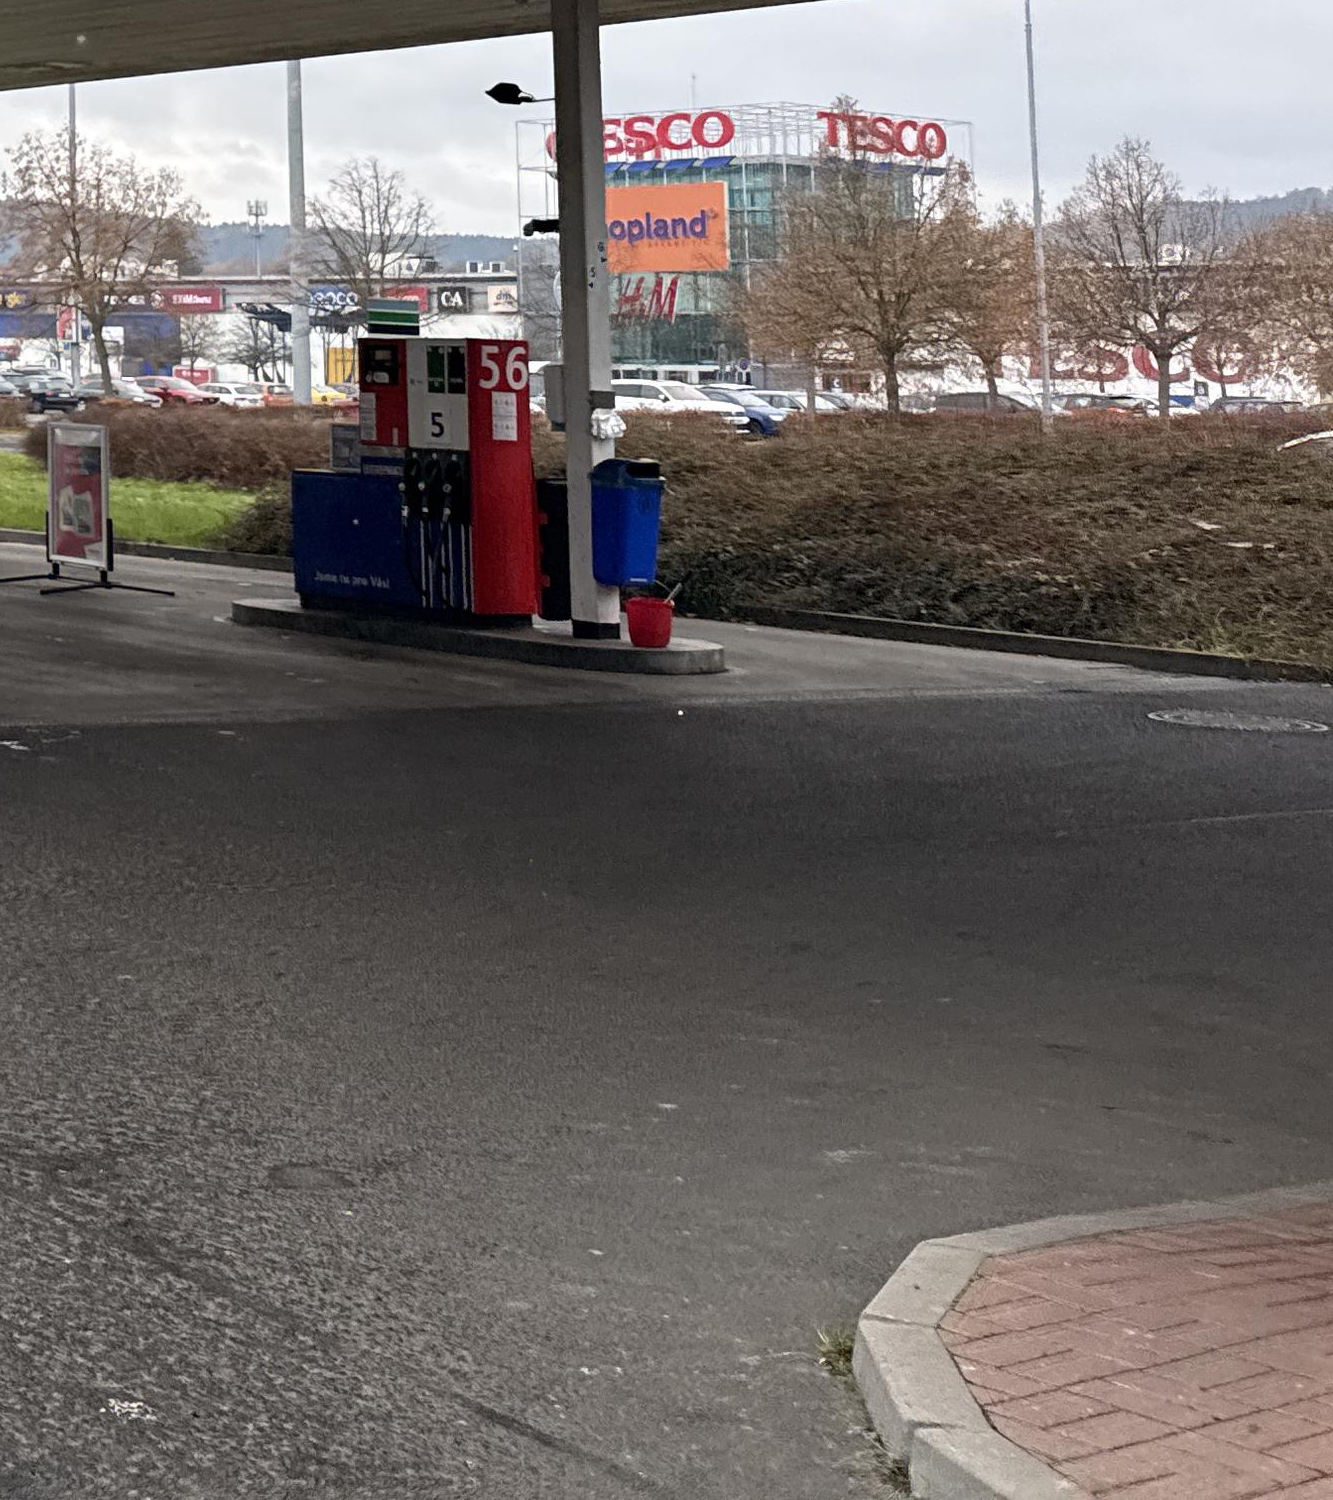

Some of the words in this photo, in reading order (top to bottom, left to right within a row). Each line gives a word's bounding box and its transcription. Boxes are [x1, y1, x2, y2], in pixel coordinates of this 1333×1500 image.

[602, 110, 735, 157] ESCO
[816, 111, 947, 160] TESCO
[607, 209, 708, 245] opland
[478, 344, 529, 391] 56
[430, 411, 445, 438] 5
